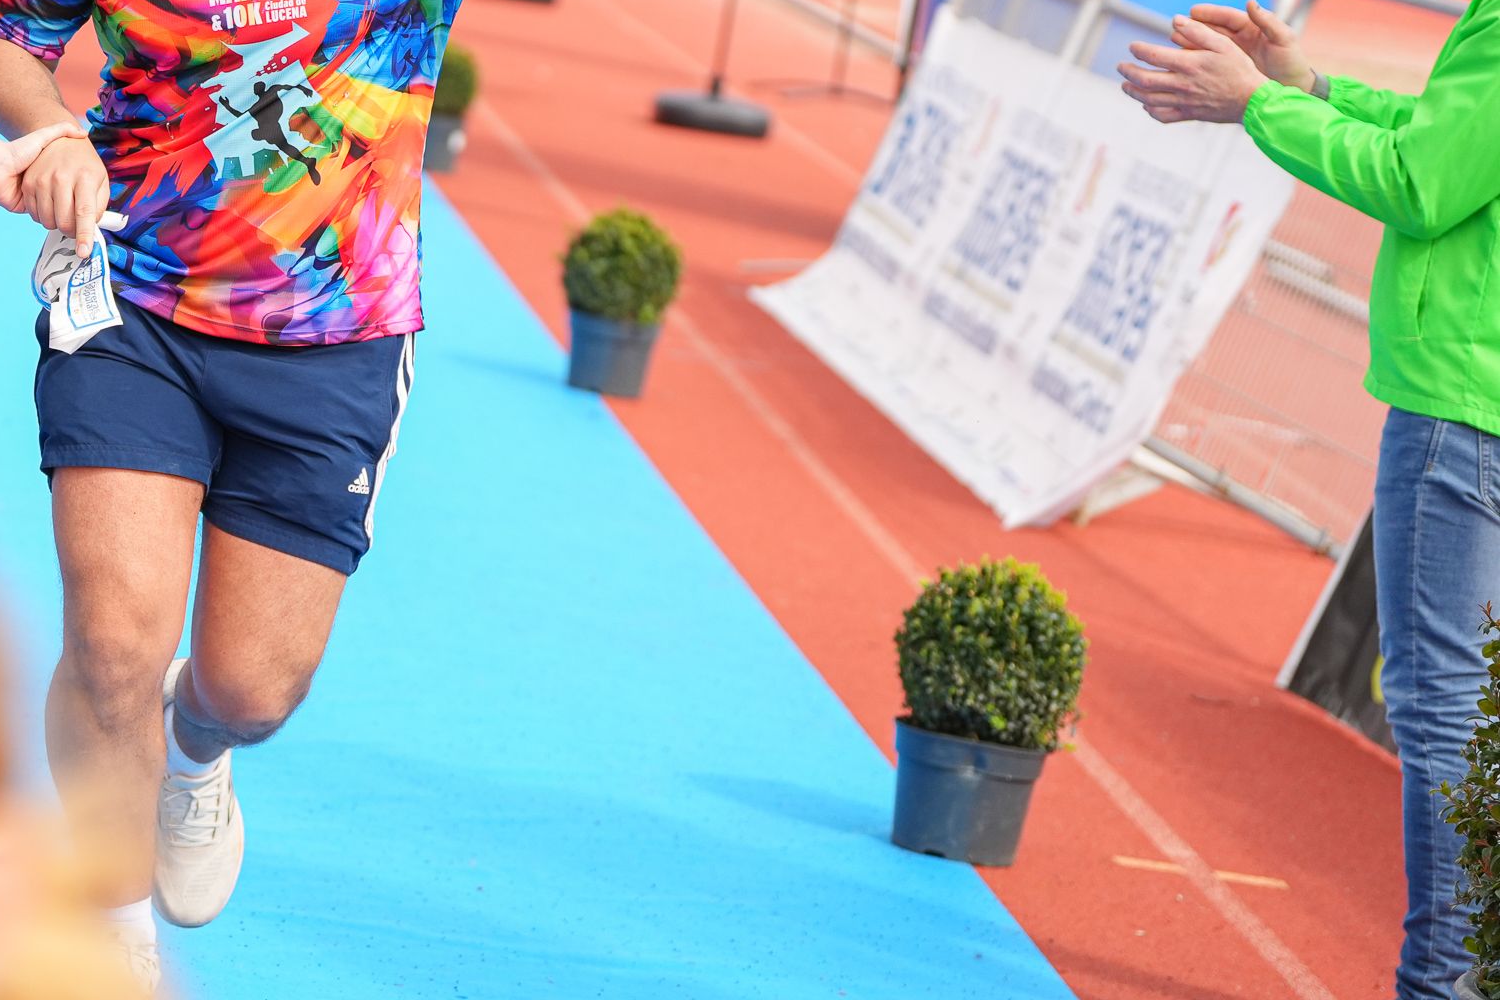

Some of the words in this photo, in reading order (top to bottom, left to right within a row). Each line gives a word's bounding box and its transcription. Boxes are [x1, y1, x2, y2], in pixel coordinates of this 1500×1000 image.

[211, 14, 223, 32] &
[223, 2, 263, 30] 10K
[265, 5, 308, 23] LUCENA
